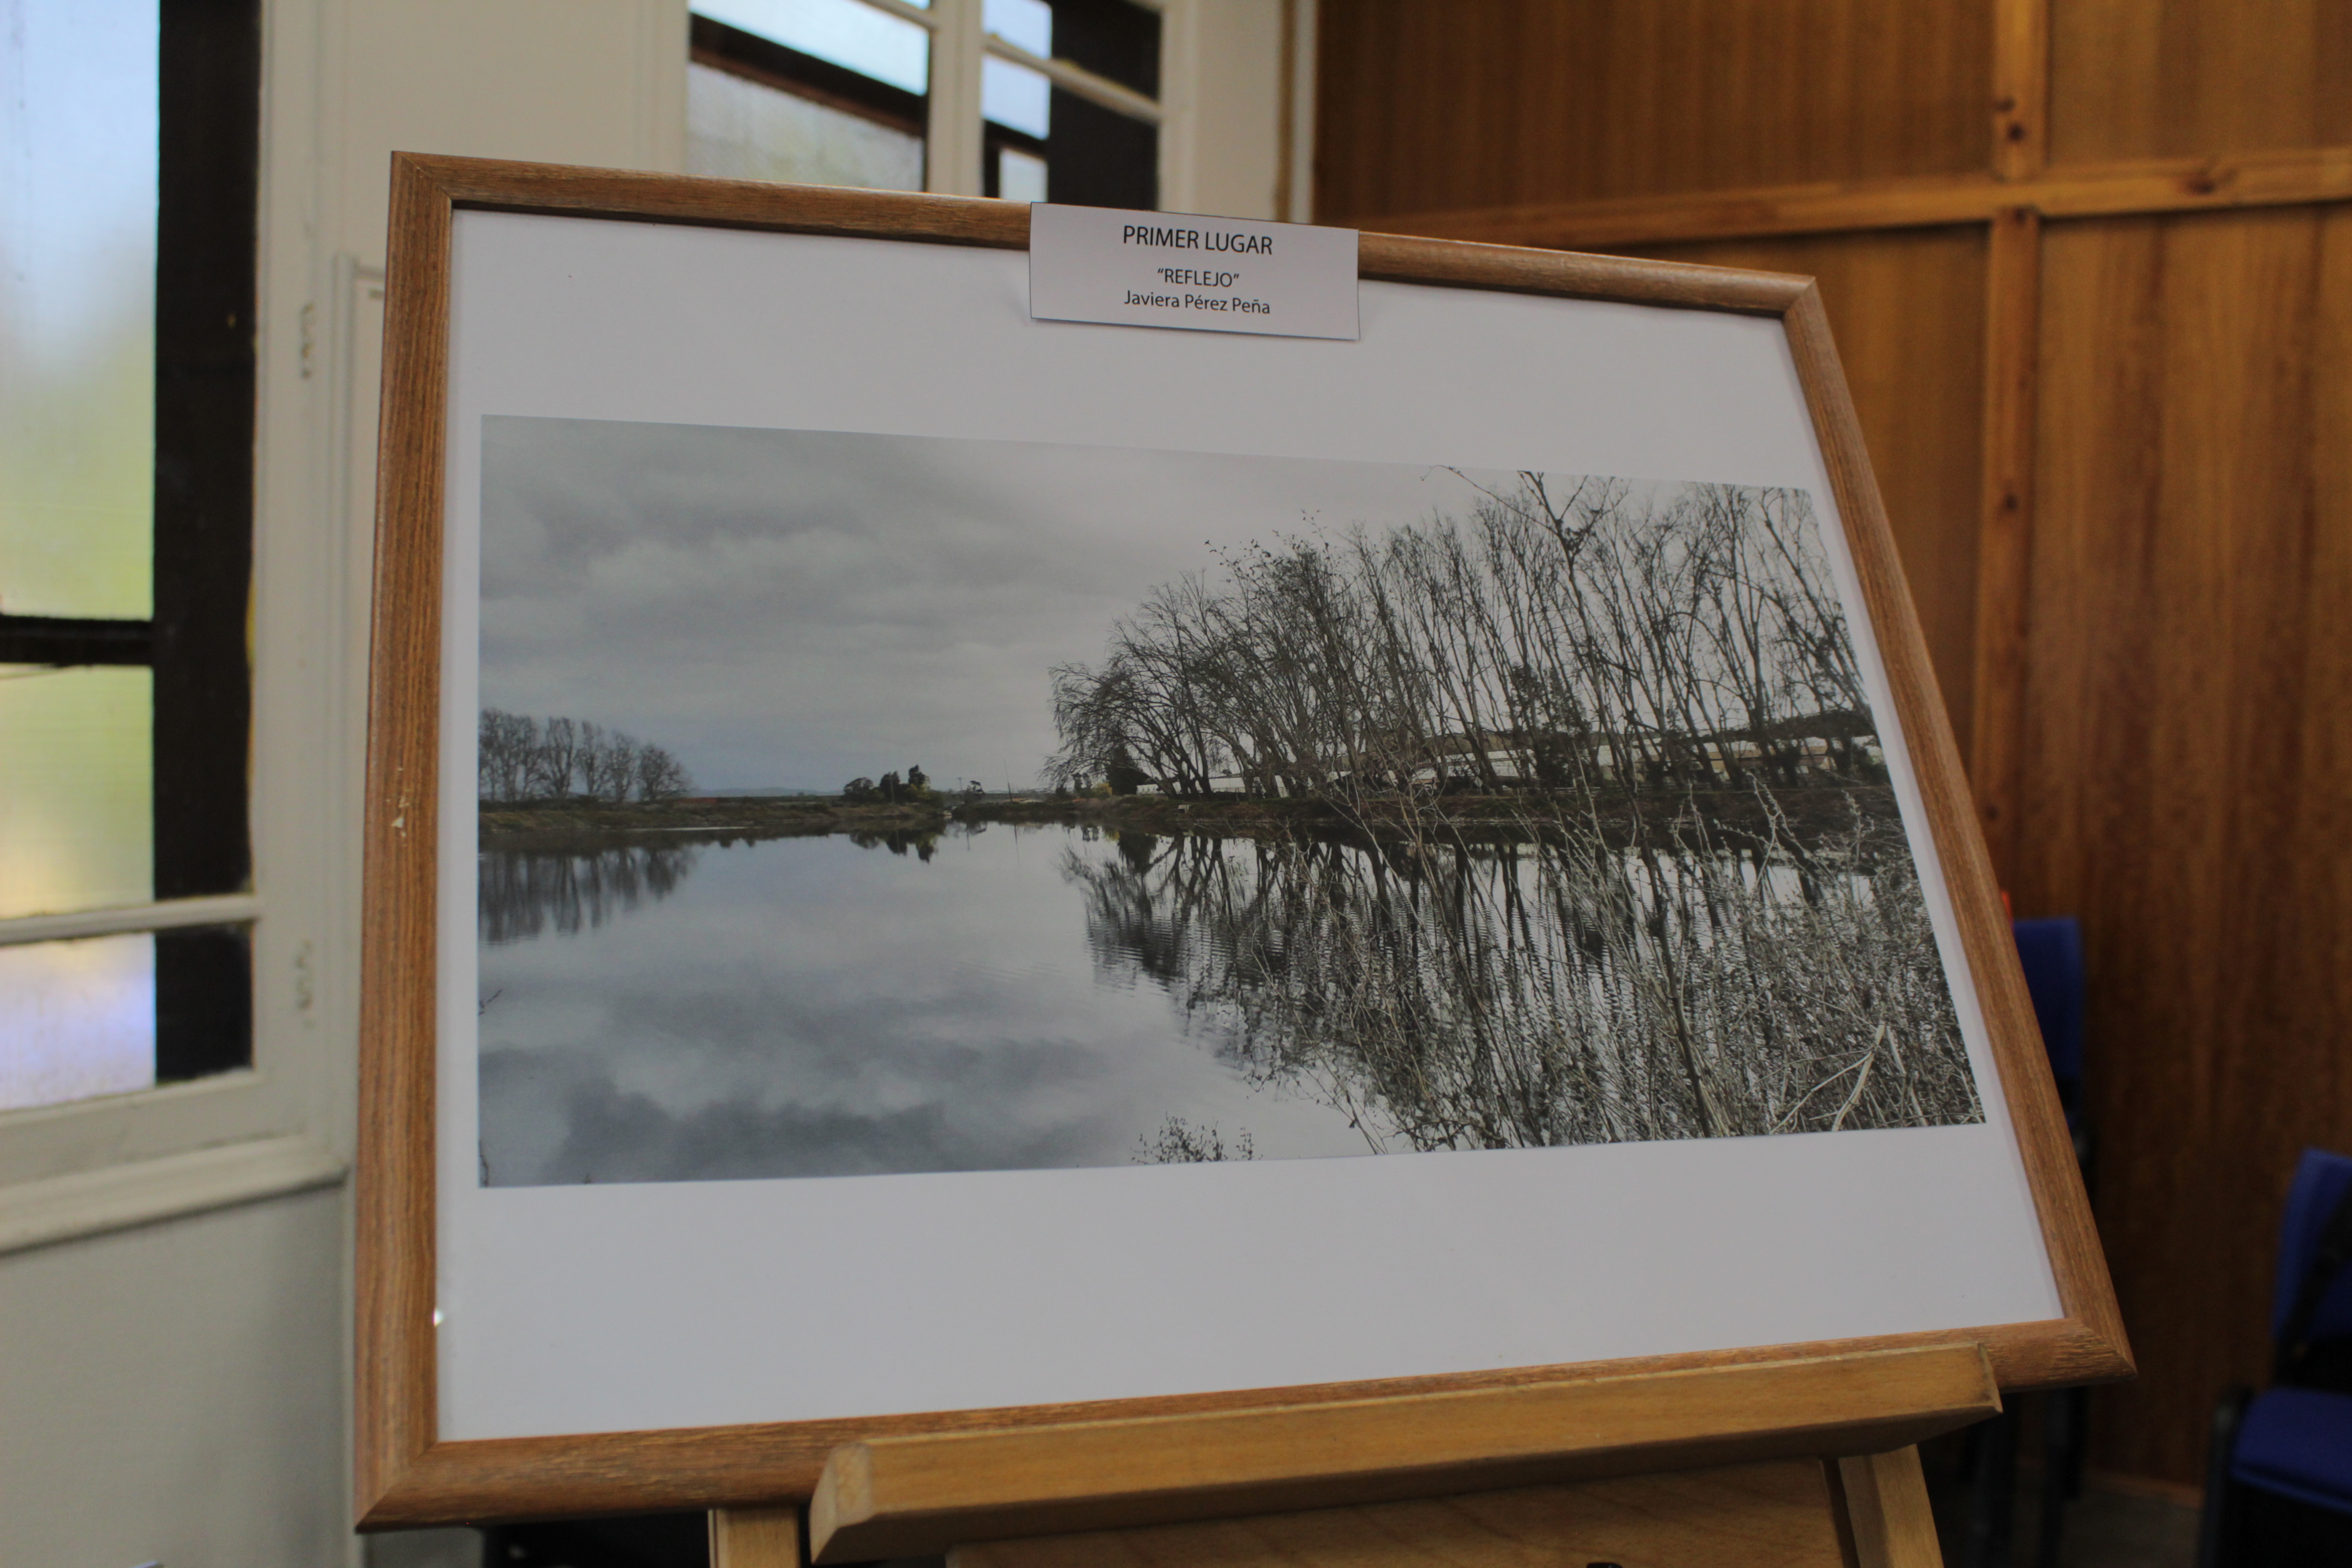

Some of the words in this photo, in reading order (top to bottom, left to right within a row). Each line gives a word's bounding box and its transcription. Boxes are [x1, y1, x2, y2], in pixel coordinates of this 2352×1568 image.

[1123, 225, 1199, 250] PRIMER
[1205, 231, 1273, 255] LUGAR
[1157, 268, 1240, 288] “REFLEJO”
[1124, 289, 1180, 308] Javiera
[1185, 294, 1228, 311] Pérez
[1232, 297, 1270, 314] Peña
